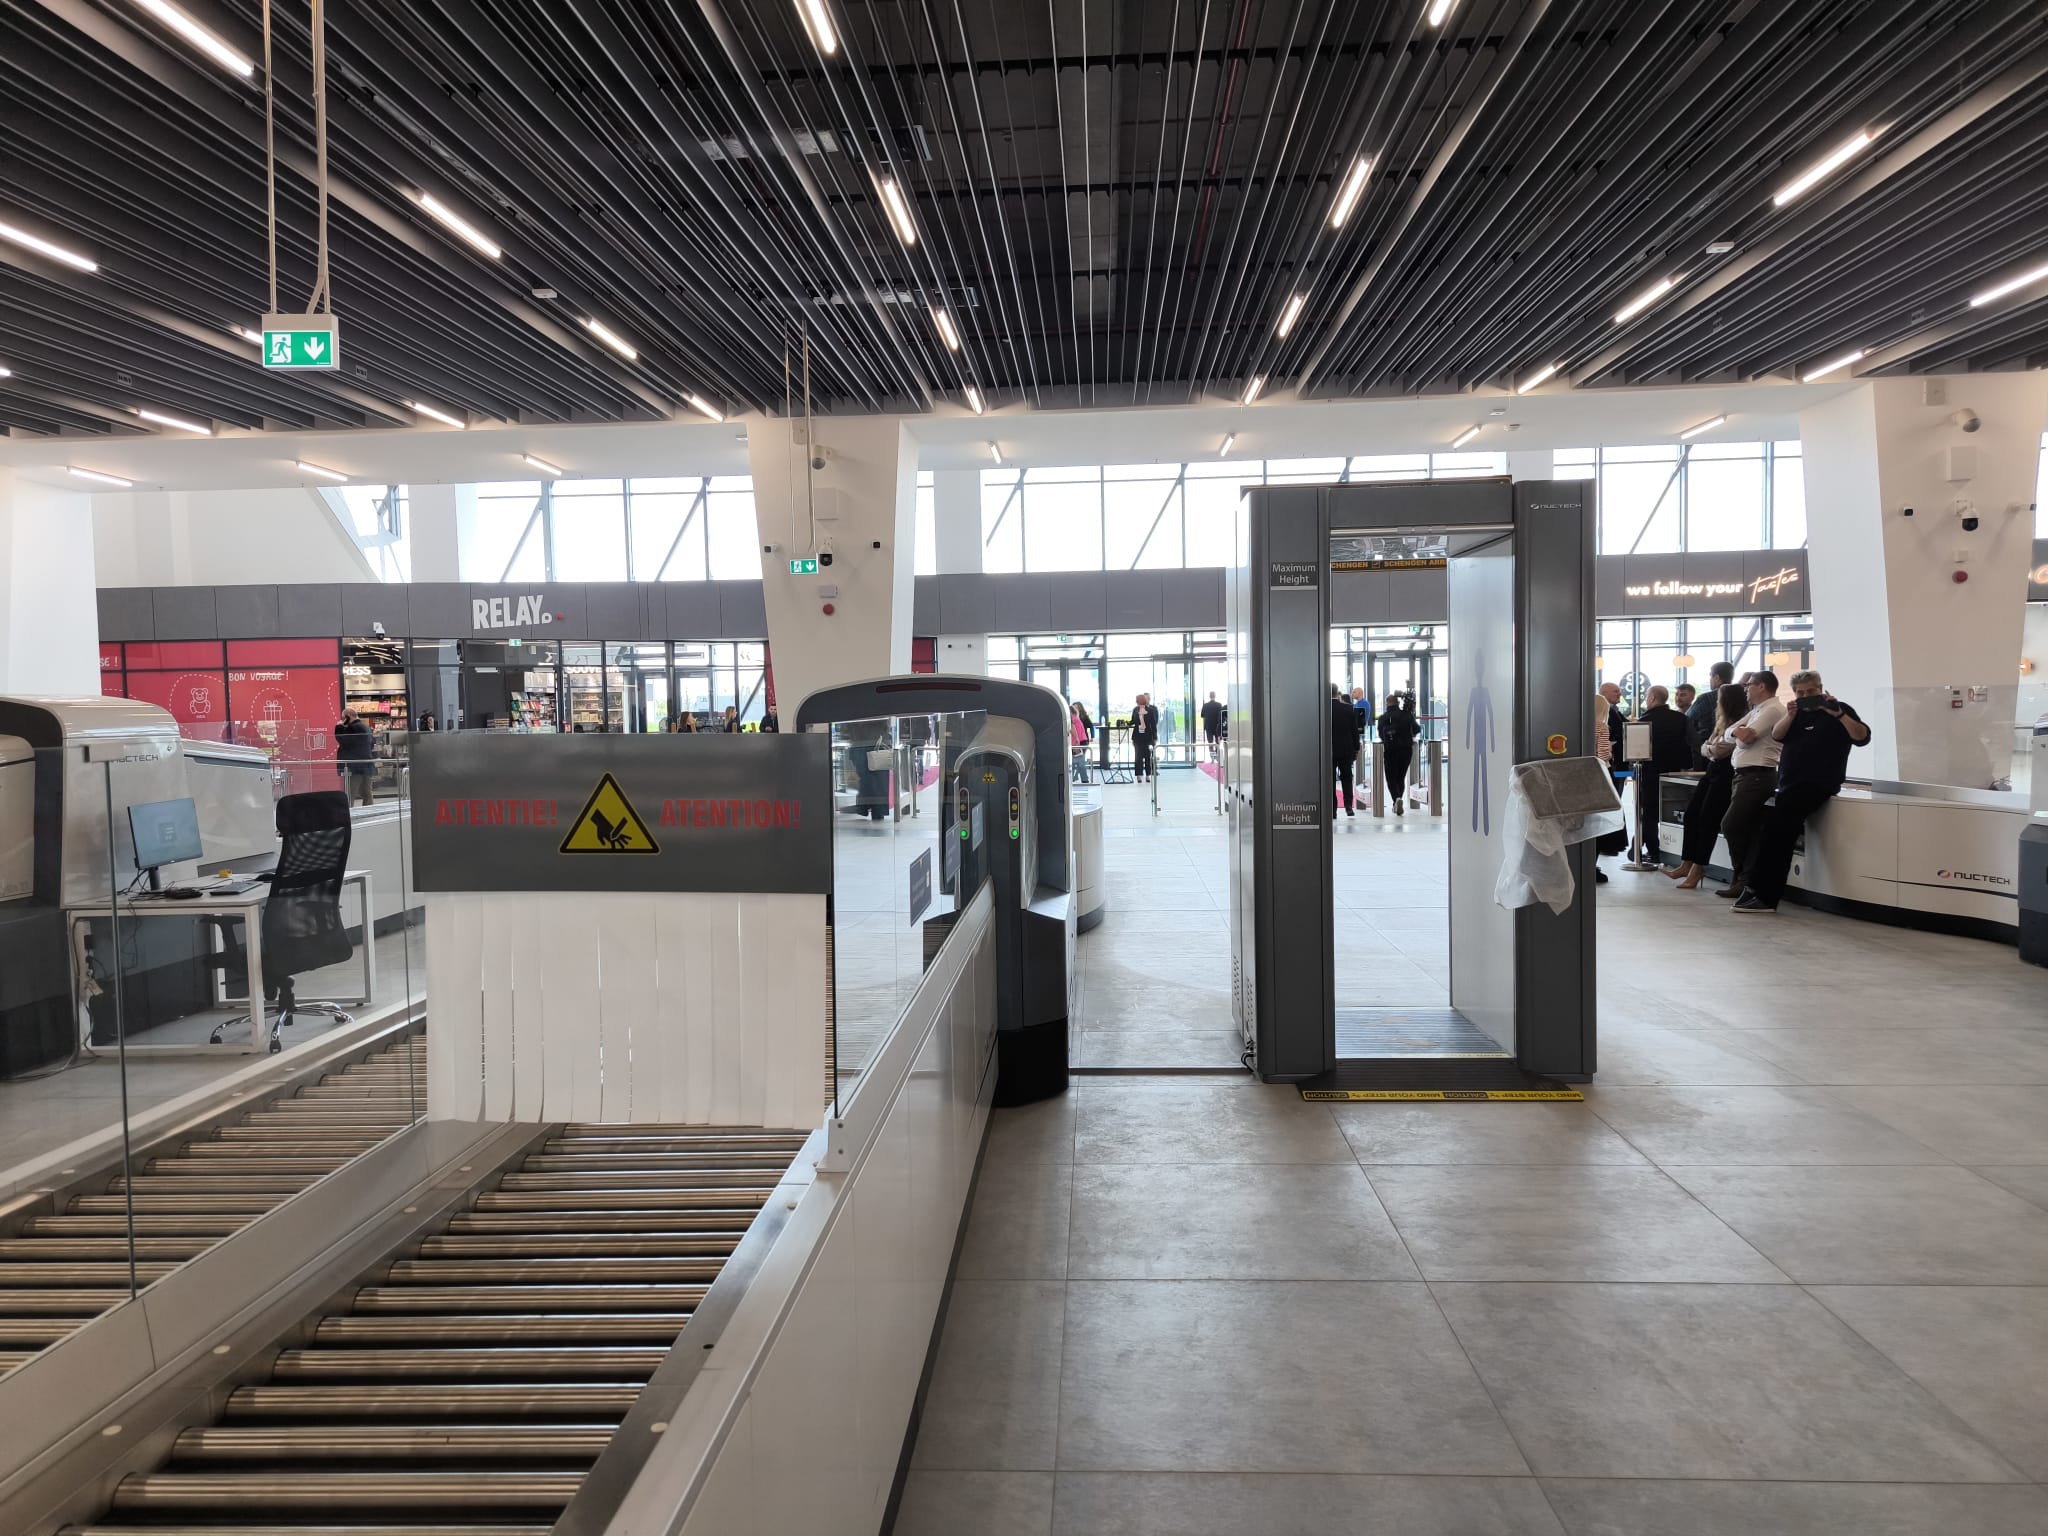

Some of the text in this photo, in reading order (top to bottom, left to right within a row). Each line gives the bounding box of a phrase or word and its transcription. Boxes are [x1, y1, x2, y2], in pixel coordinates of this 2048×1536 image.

[1272, 563, 1316, 572] Maximum
[1279, 574, 1309, 585] Height
[1626, 567, 1798, 604] we follow your tastes
[228, 672, 246, 682] BON
[111, 754, 159, 763] CTECH
[1275, 802, 1317, 812] Minimum
[435, 799, 801, 829] ATENTIE! ATENTION!
[1281, 813, 1310, 824] Height
[1954, 872, 2010, 885] NUCTECH
